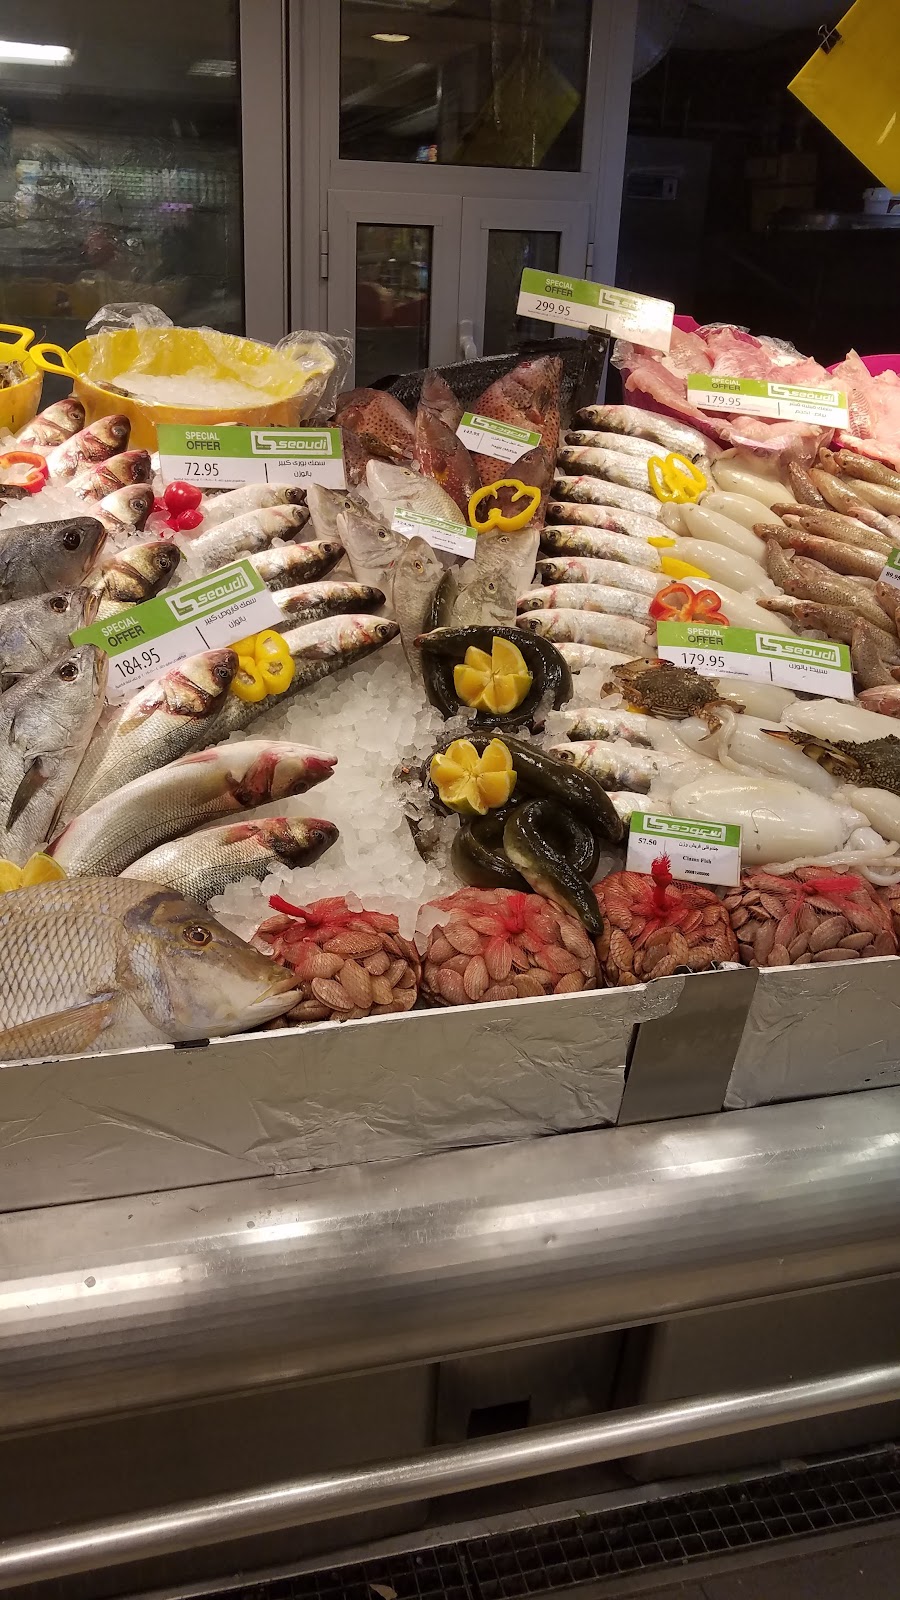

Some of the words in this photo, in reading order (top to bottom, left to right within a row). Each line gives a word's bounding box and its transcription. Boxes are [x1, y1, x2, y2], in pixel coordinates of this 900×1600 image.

[546, 278, 573, 290] SPECIAL
[544, 285, 573, 297] OFFER
[535, 300, 571, 316] 299.95
[711, 377, 741, 386] SPECIAL
[711, 383, 741, 391] OFFER
[705, 394, 741, 407] 179.95
[185, 431, 220, 441] SPECIAL
[186, 440, 221, 451] OFFER
[184, 462, 219, 476] 72.95
[101, 616, 140, 637] SPECIAL
[687, 627, 723, 637] SPECIAL
[107, 624, 146, 648] OFFER
[687, 635, 724, 646] OFFER
[114, 648, 161, 678] 184.95
[681, 652, 725, 668] 179.95
[638, 838, 657, 846] 57.50
